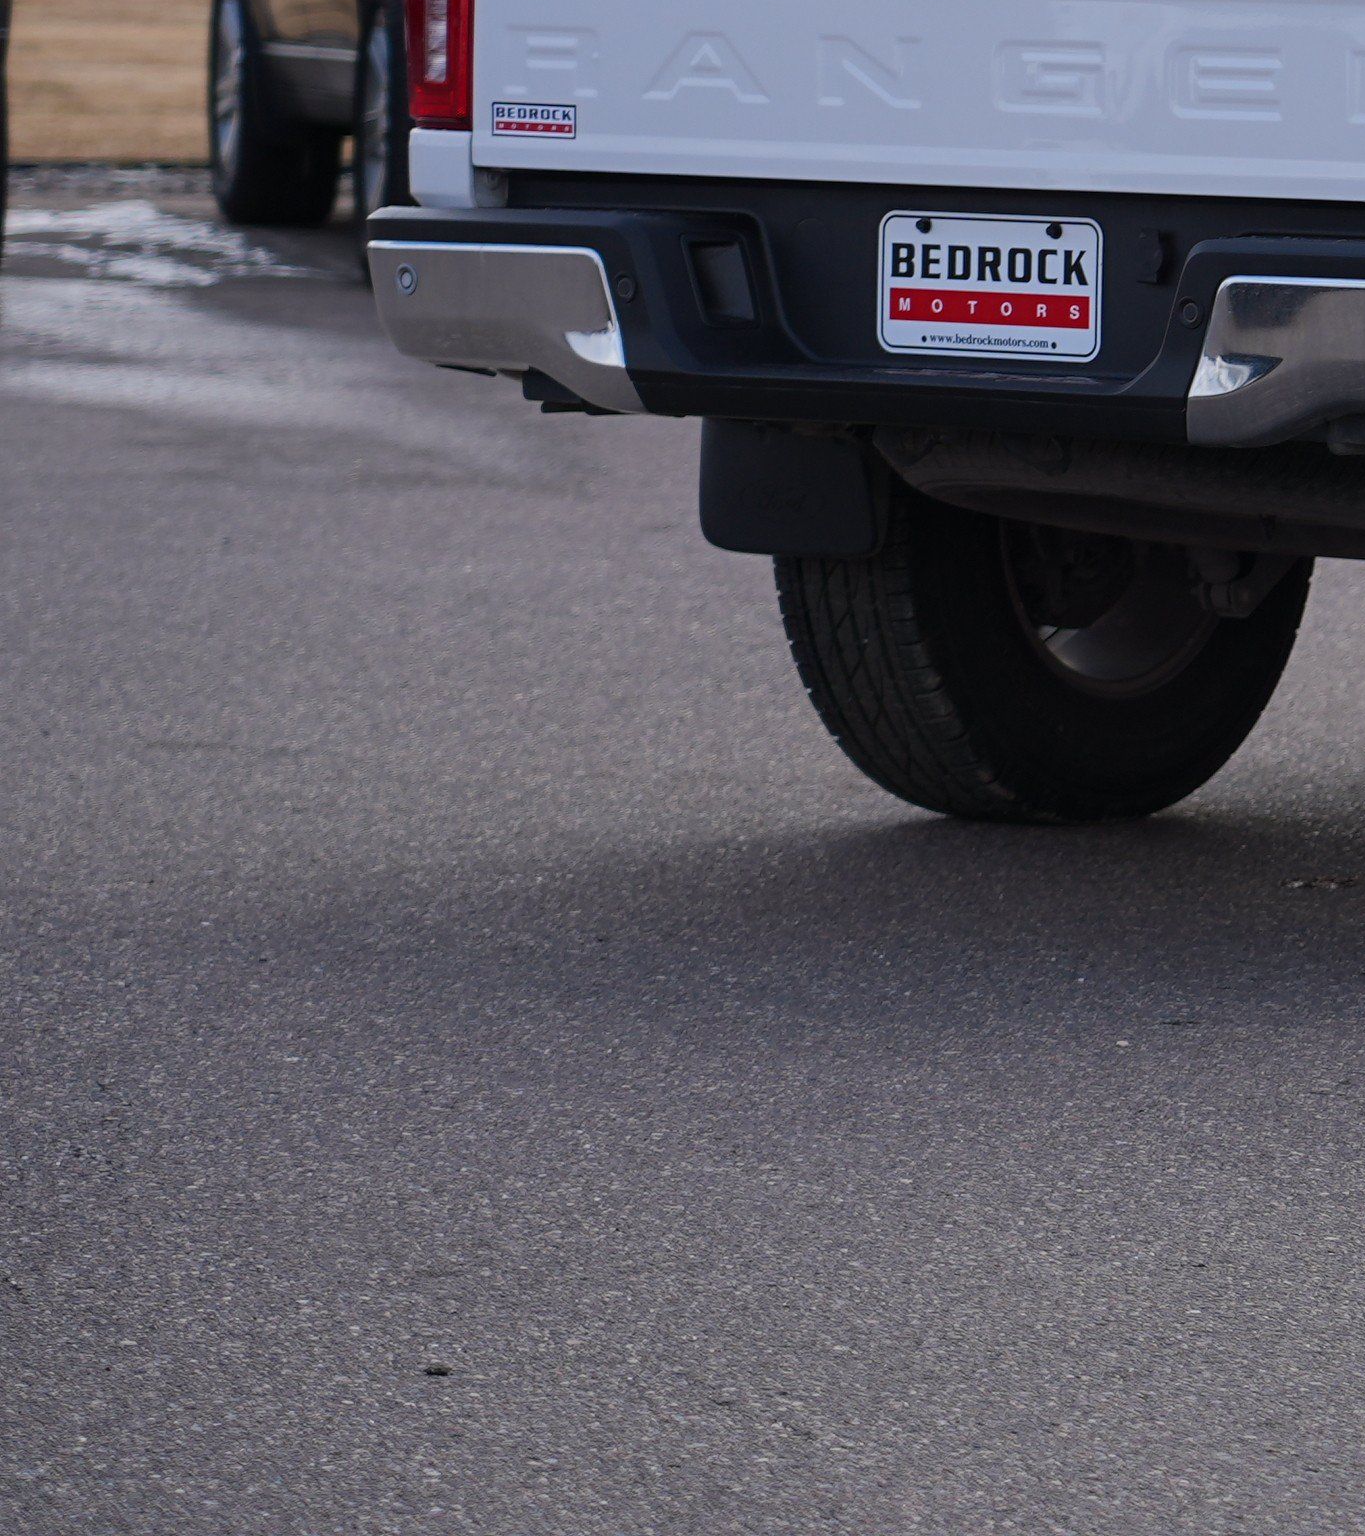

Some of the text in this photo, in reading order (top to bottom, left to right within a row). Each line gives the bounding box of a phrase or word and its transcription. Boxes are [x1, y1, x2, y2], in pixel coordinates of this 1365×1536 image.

[495, 107, 572, 121] BEDROCK
[890, 242, 1089, 286] BEDROCK
[898, 296, 1081, 321] MOTORS
[929, 332, 1049, 349] www.bedrockmotors.com
